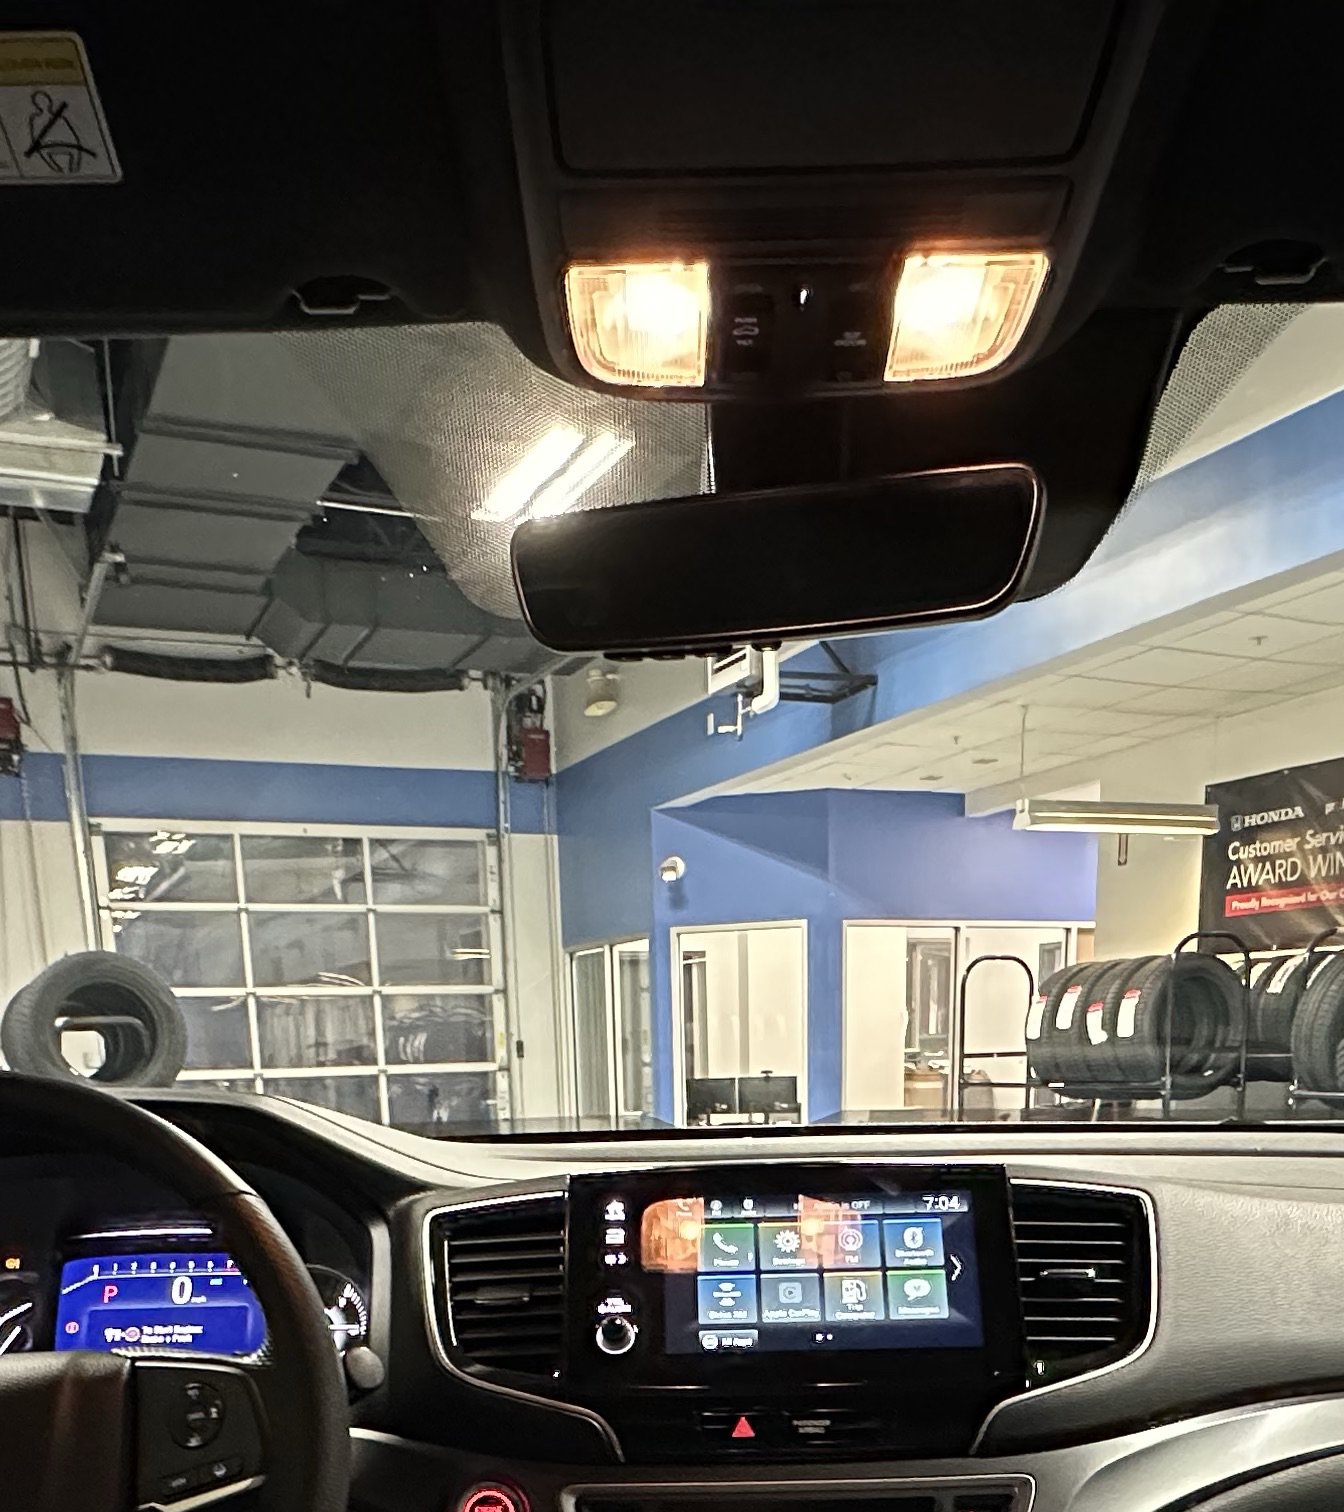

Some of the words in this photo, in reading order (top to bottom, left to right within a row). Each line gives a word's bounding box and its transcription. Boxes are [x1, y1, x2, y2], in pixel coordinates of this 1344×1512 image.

[1243, 805, 1305, 829] HONDA
[1227, 834, 1301, 862] Customer
[1226, 857, 1302, 890] AWARD
[922, 1196, 960, 1212] 7:04
[103, 1285, 118, 1303] P
[171, 1275, 193, 1305] 0
